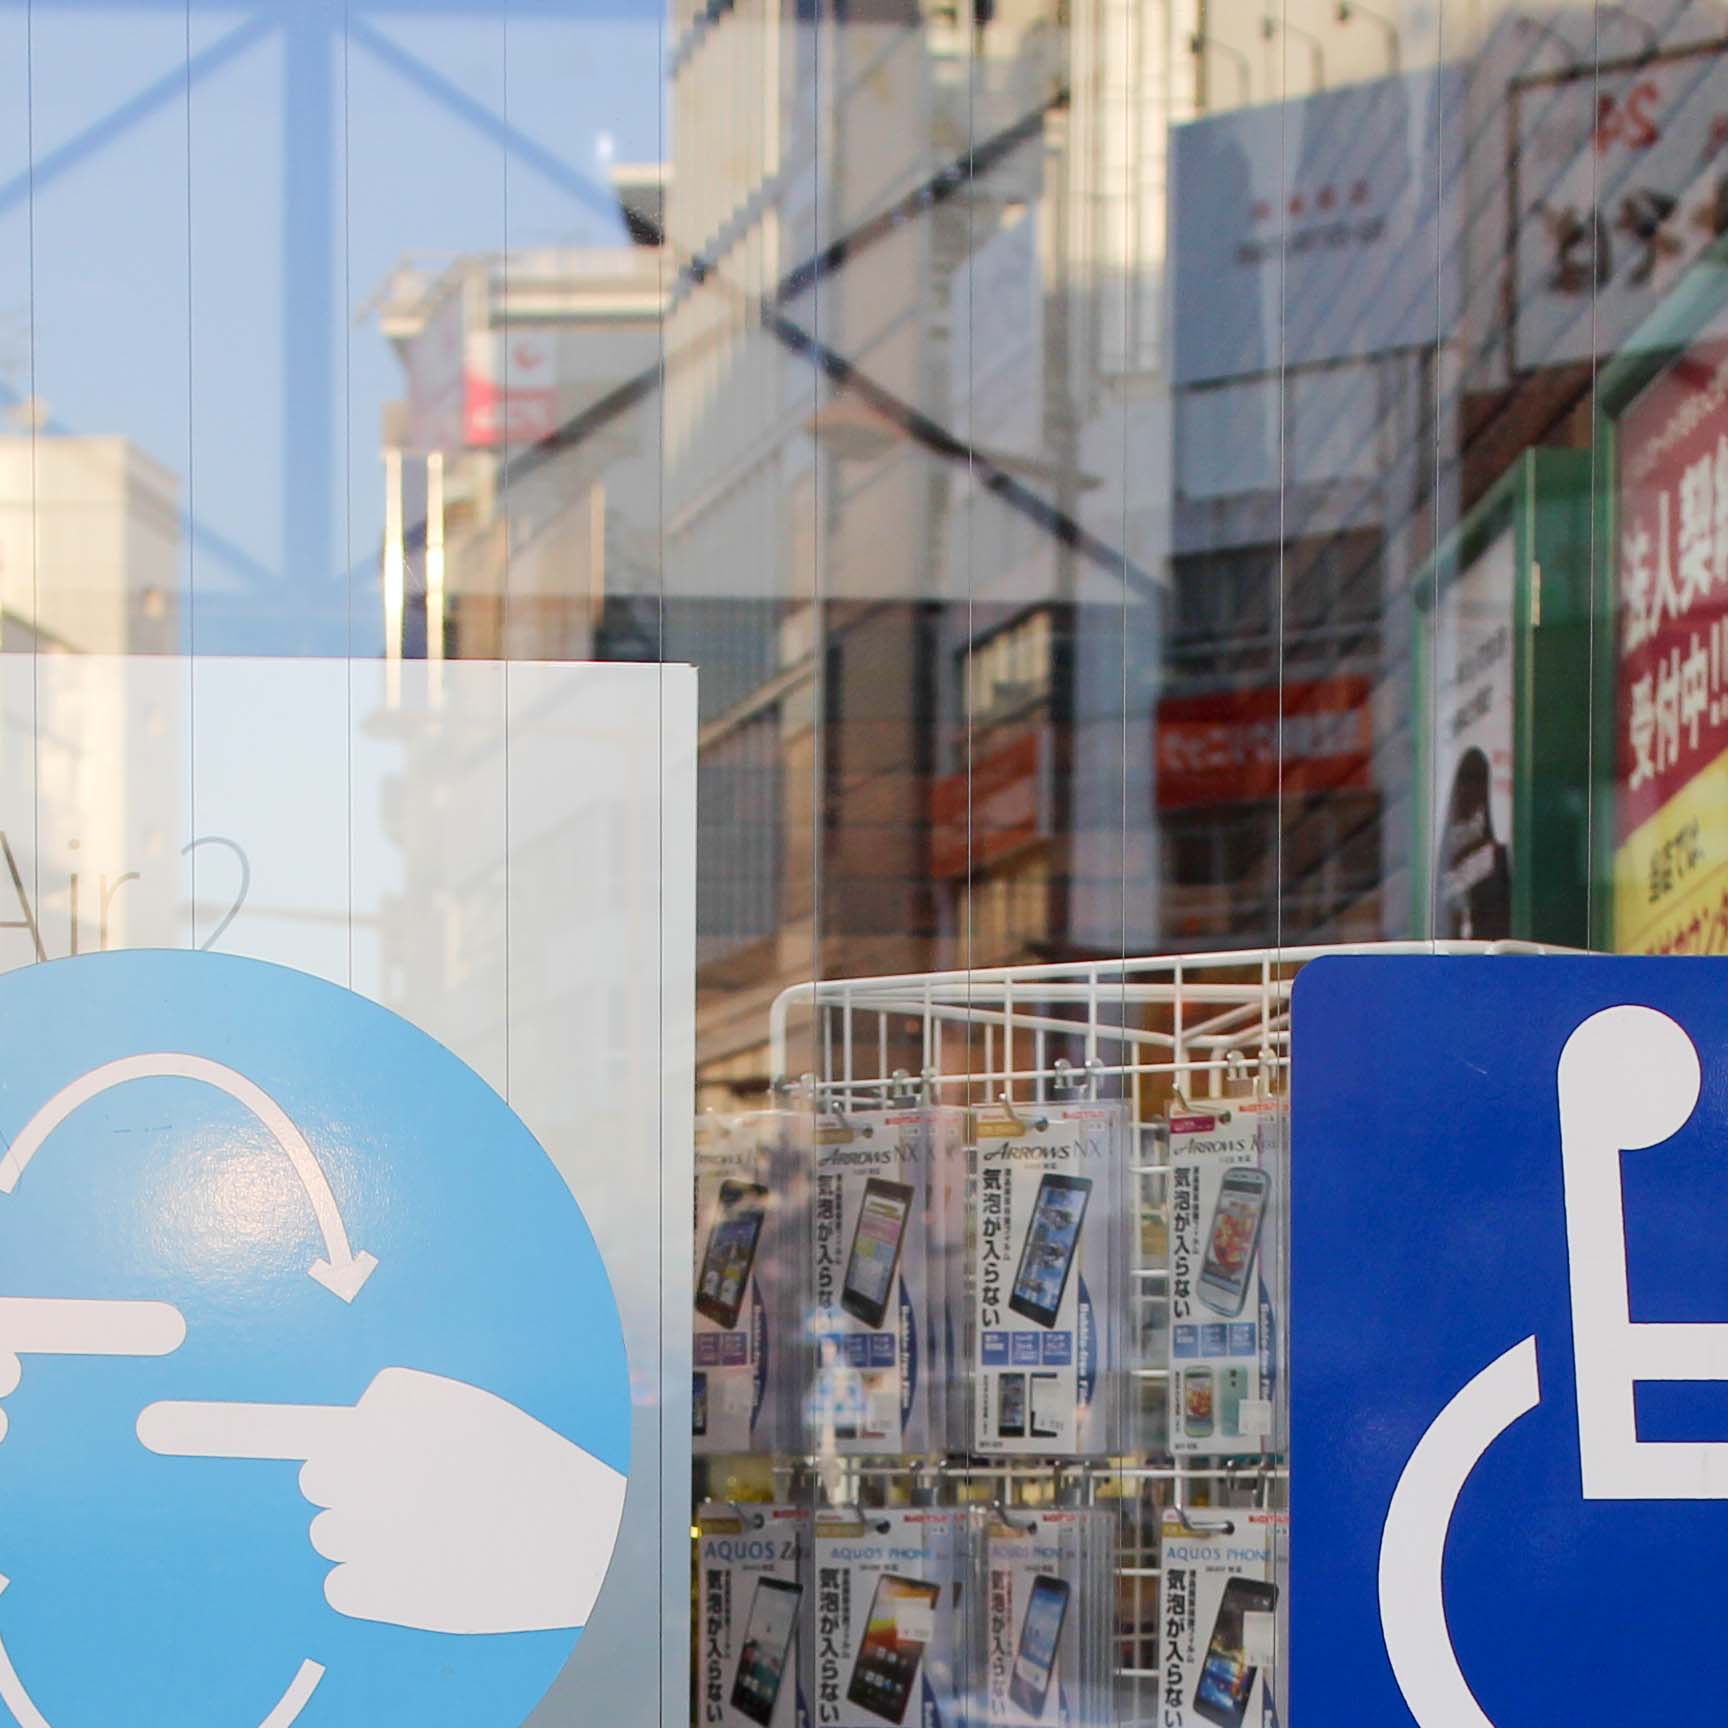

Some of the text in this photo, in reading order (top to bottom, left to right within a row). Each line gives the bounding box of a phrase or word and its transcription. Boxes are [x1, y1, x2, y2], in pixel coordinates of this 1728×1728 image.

[179, 836, 250, 952] 2
[983, 1141, 1071, 1161] ARROWS
[981, 1168, 1001, 1328] 気泡が入らない
[1173, 1166, 1191, 1319] 気泡が入らない
[704, 1540, 776, 1563] AQUOS
[1167, 1546, 1221, 1562] AQUOS
[706, 1569, 723, 1723] 気泡が入らない
[819, 1567, 840, 1723] 気泡が入らない
[1164, 1568, 1186, 1728] 気泡が入らない
